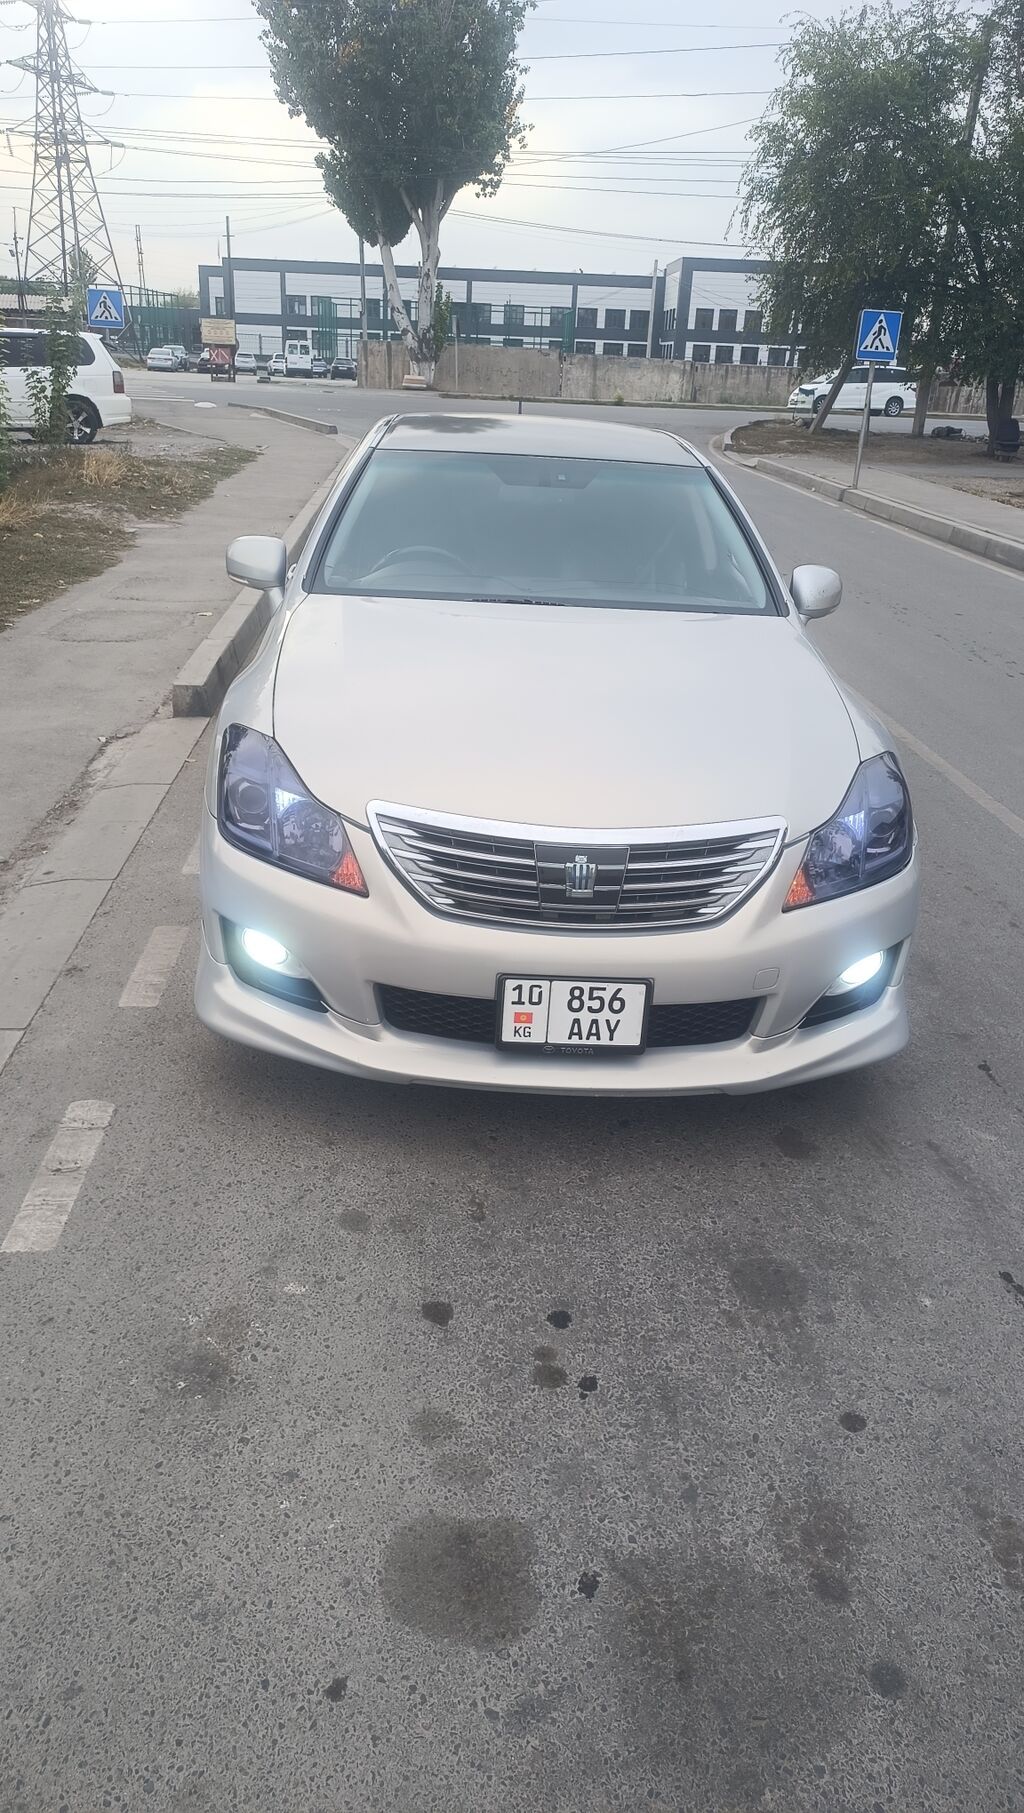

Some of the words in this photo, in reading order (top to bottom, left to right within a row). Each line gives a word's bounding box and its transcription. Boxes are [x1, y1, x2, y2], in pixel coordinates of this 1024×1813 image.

[511, 984, 543, 1006] 10
[567, 986, 626, 1014] 856
[513, 1026, 532, 1038] KG
[567, 1018, 621, 1041] AAY
[560, 1047, 594, 1055] TOYOTA
